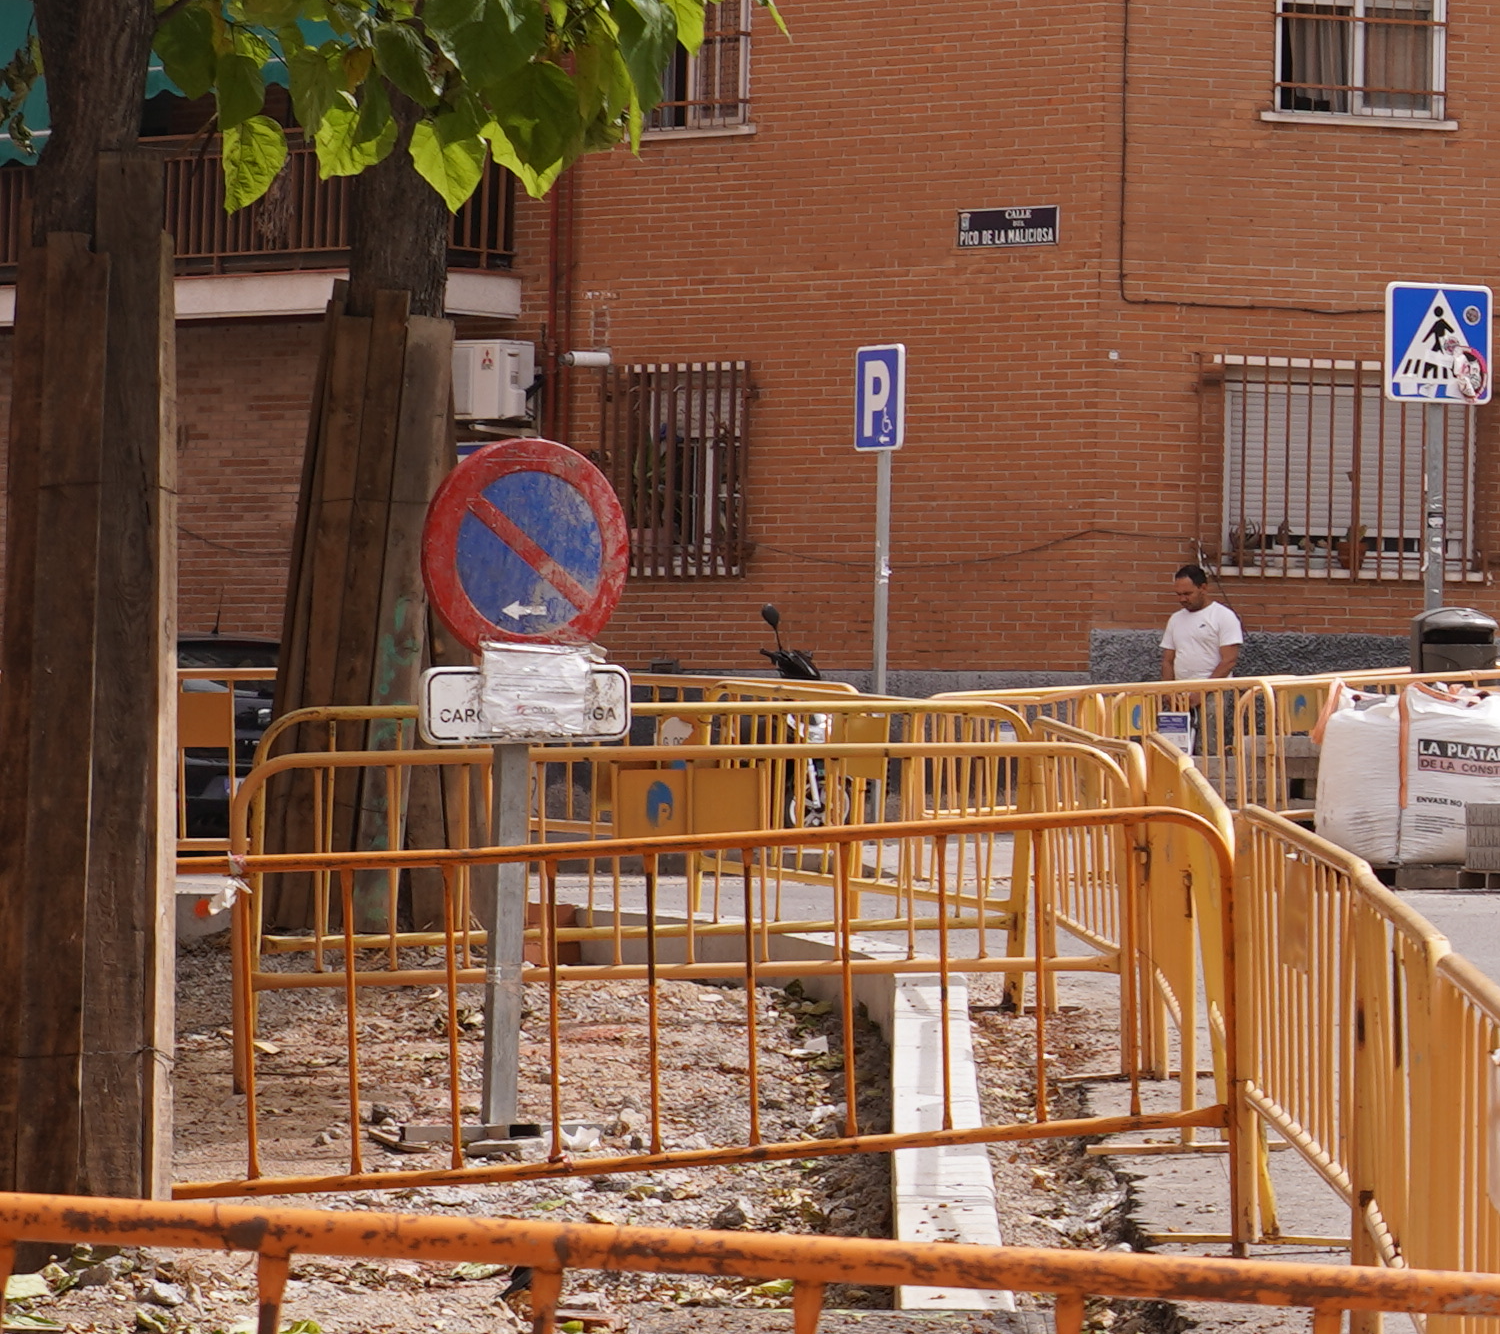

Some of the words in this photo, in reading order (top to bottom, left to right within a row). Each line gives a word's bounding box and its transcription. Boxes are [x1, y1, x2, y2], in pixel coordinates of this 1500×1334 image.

[1005, 209, 1032, 219] CALLE
[960, 231, 979, 245] PICO
[982, 230, 993, 244] DE
[995, 229, 1006, 243] LA
[1008, 227, 1054, 243] MALICIOSA
[863, 360, 891, 438] P
[1419, 741, 1440, 755] LA
[1420, 759, 1437, 769] DE
[1440, 762, 1455, 771] LA
[1416, 796, 1448, 805] ENVASE
[1450, 799, 1462, 808] NO
